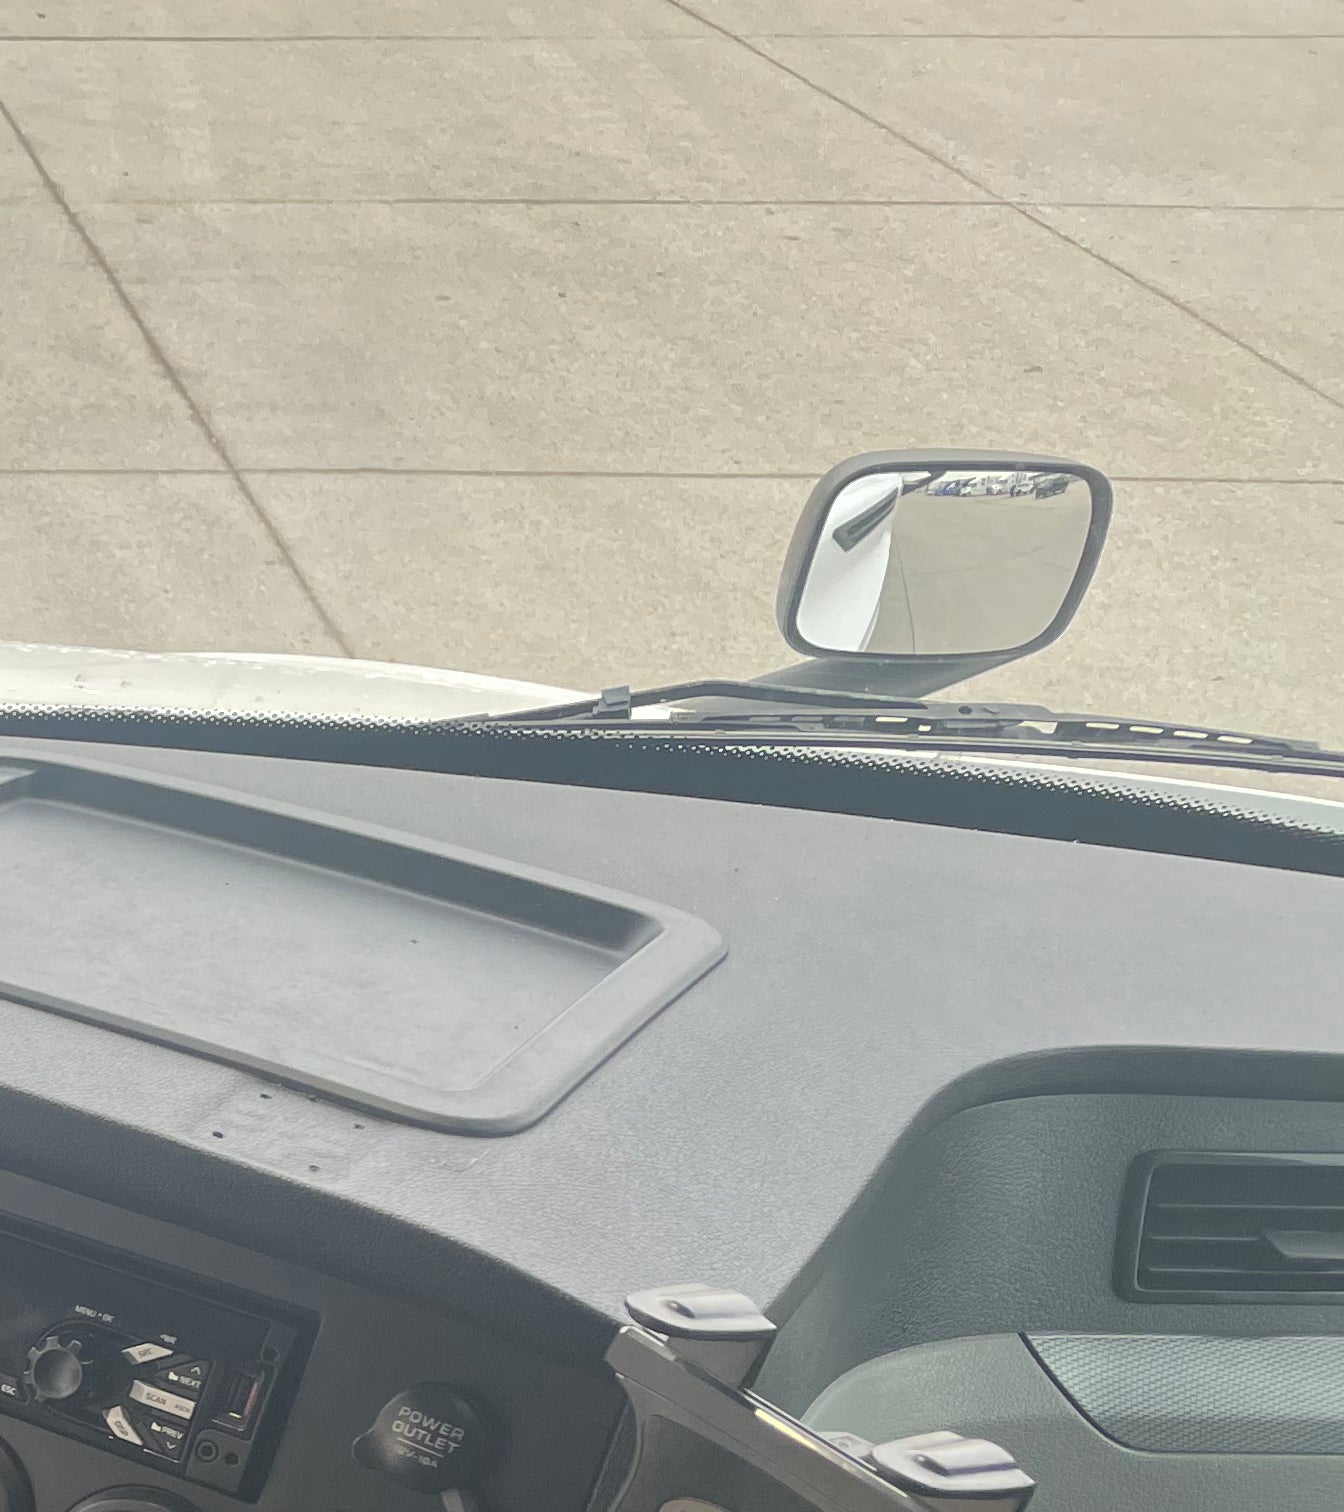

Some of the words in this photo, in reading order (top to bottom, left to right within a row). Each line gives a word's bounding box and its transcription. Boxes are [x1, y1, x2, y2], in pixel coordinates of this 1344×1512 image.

[179, 1375, 202, 1389] NEXT
[145, 1392, 167, 1406] SCAN
[398, 1406, 465, 1441] POWER
[161, 1425, 184, 1440] PREV
[392, 1420, 460, 1453] OUTLET
